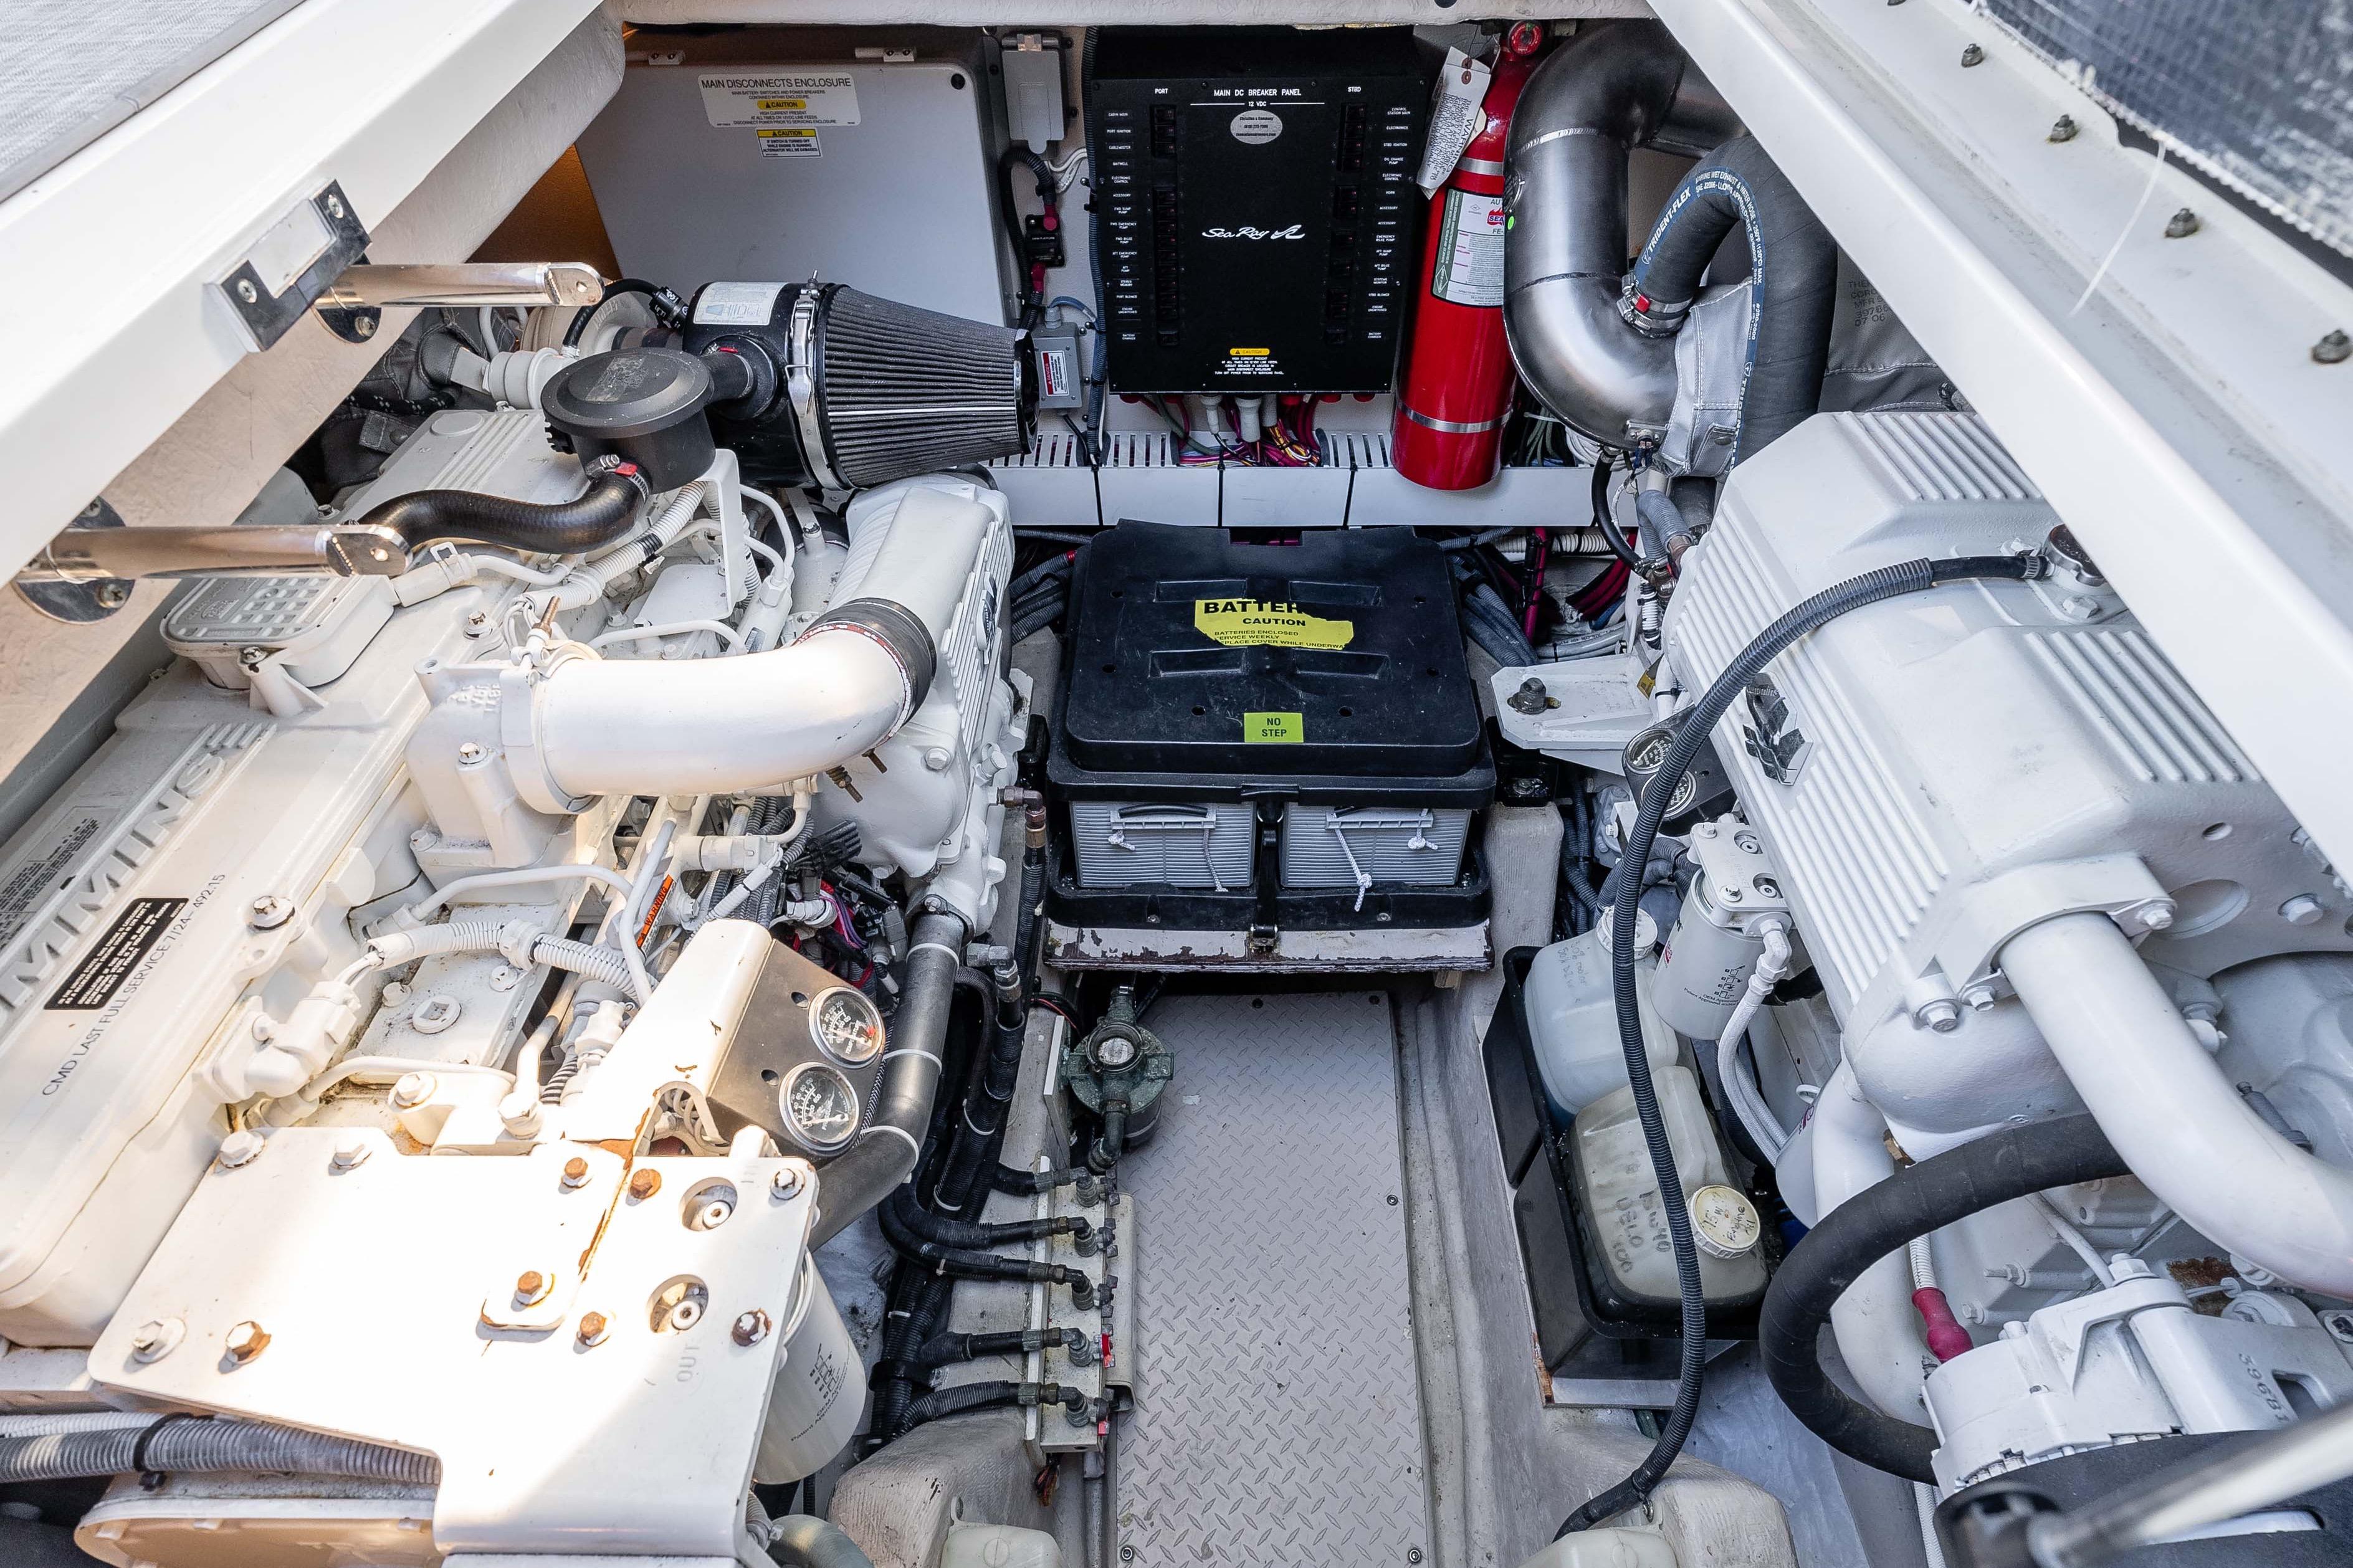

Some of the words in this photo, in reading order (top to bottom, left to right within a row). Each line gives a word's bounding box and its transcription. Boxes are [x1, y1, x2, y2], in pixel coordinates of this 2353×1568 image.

[702, 80, 725, 88] MAIN
[727, 78, 793, 88] DISCONNECTS
[796, 78, 851, 87] ENCLOSURE
[1446, 118, 1473, 173] WARNING
[1720, 171, 1738, 186] EXHAUST
[1740, 186, 1751, 204] WATER
[1202, 229, 1235, 237] Sea
[1236, 227, 1269, 239] Ray
[1648, 186, 1691, 253] TRIDENT-FLEX
[1243, 618, 1305, 627] CAUTION
[645, 886, 667, 926] WARNING
[42, 1059, 77, 1096] CMD
[73, 1027, 104, 1056] LAST
[99, 995, 130, 1024] FULL
[123, 944, 171, 994] SERVICE
[194, 873, 225, 908] 492.15
